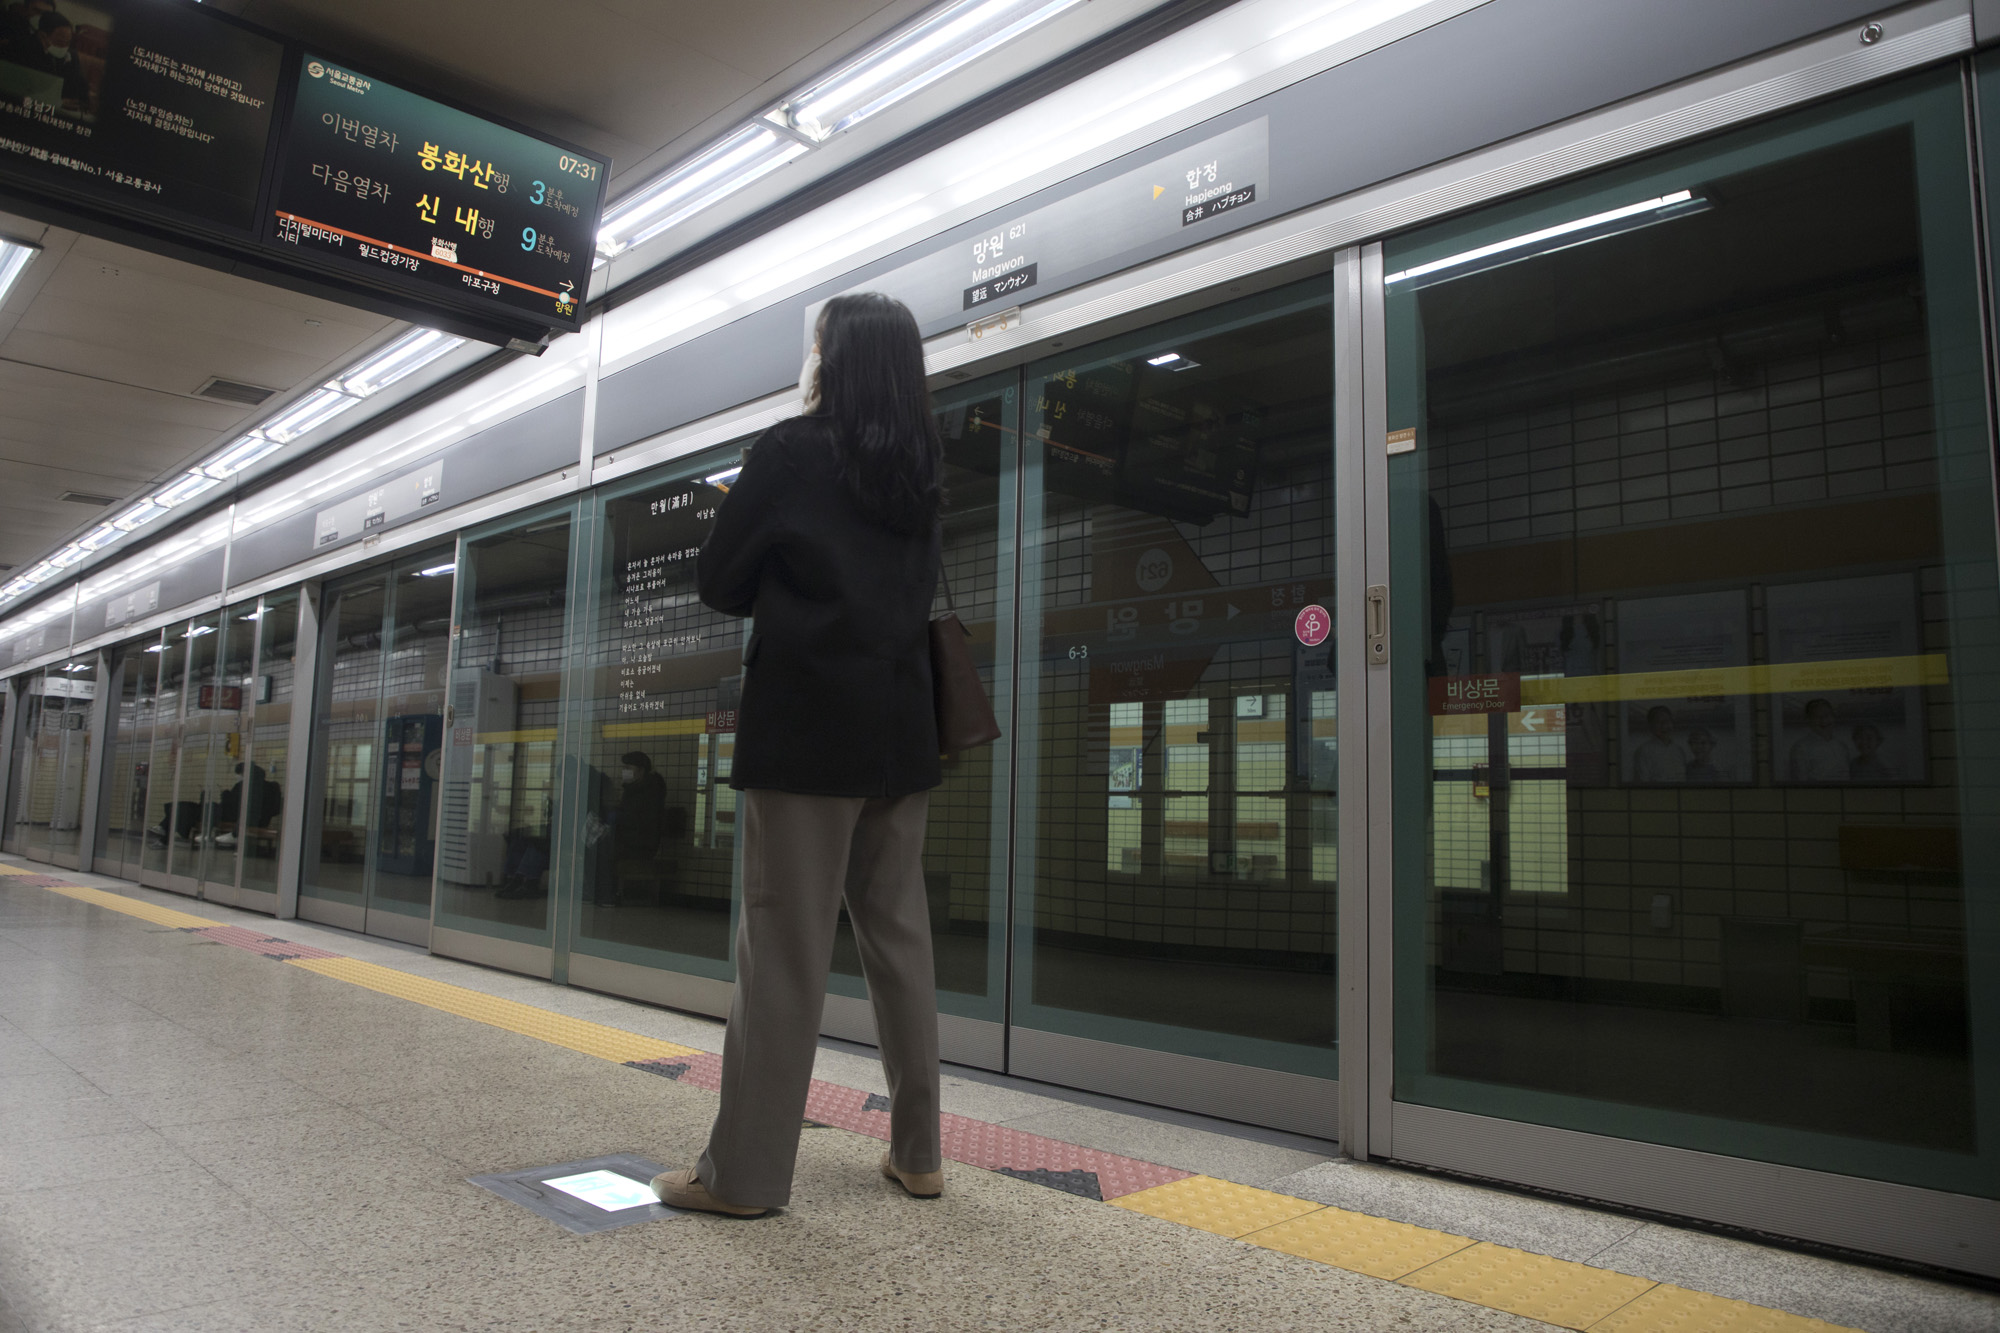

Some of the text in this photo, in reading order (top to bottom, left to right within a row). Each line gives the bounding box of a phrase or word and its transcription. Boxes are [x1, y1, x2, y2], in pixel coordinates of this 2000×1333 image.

[169, 69, 202, 89] 하는것이
[204, 82, 229, 98] 당연한
[180, 63, 206, 79] 지자체
[207, 72, 243, 92] 사무이고)
[325, 67, 371, 91] 서울교통공사
[329, 77, 364, 95] Seoul Metro
[321, 112, 400, 153] 이번열차
[559, 155, 596, 182] 07:31
[1185, 160, 1218, 190] 합정
[105, 169, 162, 194] 서울교통공사
[311, 164, 391, 205] 다음열차
[529, 180, 564, 205] 3 분후
[1185, 182, 1232, 206] Hapjeong
[544, 198, 579, 218] 도착예정
[1185, 191, 1252, 222] 合井 ハプチョン
[276, 230, 299, 245] 시티
[279, 218, 344, 246] 디지털미디어
[520, 227, 555, 252] 9 분후
[973, 223, 1026, 264] 망원 621
[358, 243, 420, 272] 월드컵경기장
[435, 248, 452, 260] 6033
[535, 245, 571, 264] 도착예정
[972, 255, 1024, 284] Mangwon
[462, 275, 501, 295] 마포구청
[993, 273, 1029, 293] マンウォン
[555, 301, 574, 316] 망원
[696, 507, 716, 520] 이남순
[1068, 645, 1088, 660] 6-3
[1446, 679, 1500, 700] 비상문
[1442, 700, 1505, 711] Emergency Door
[708, 711, 735, 728] 비상문
